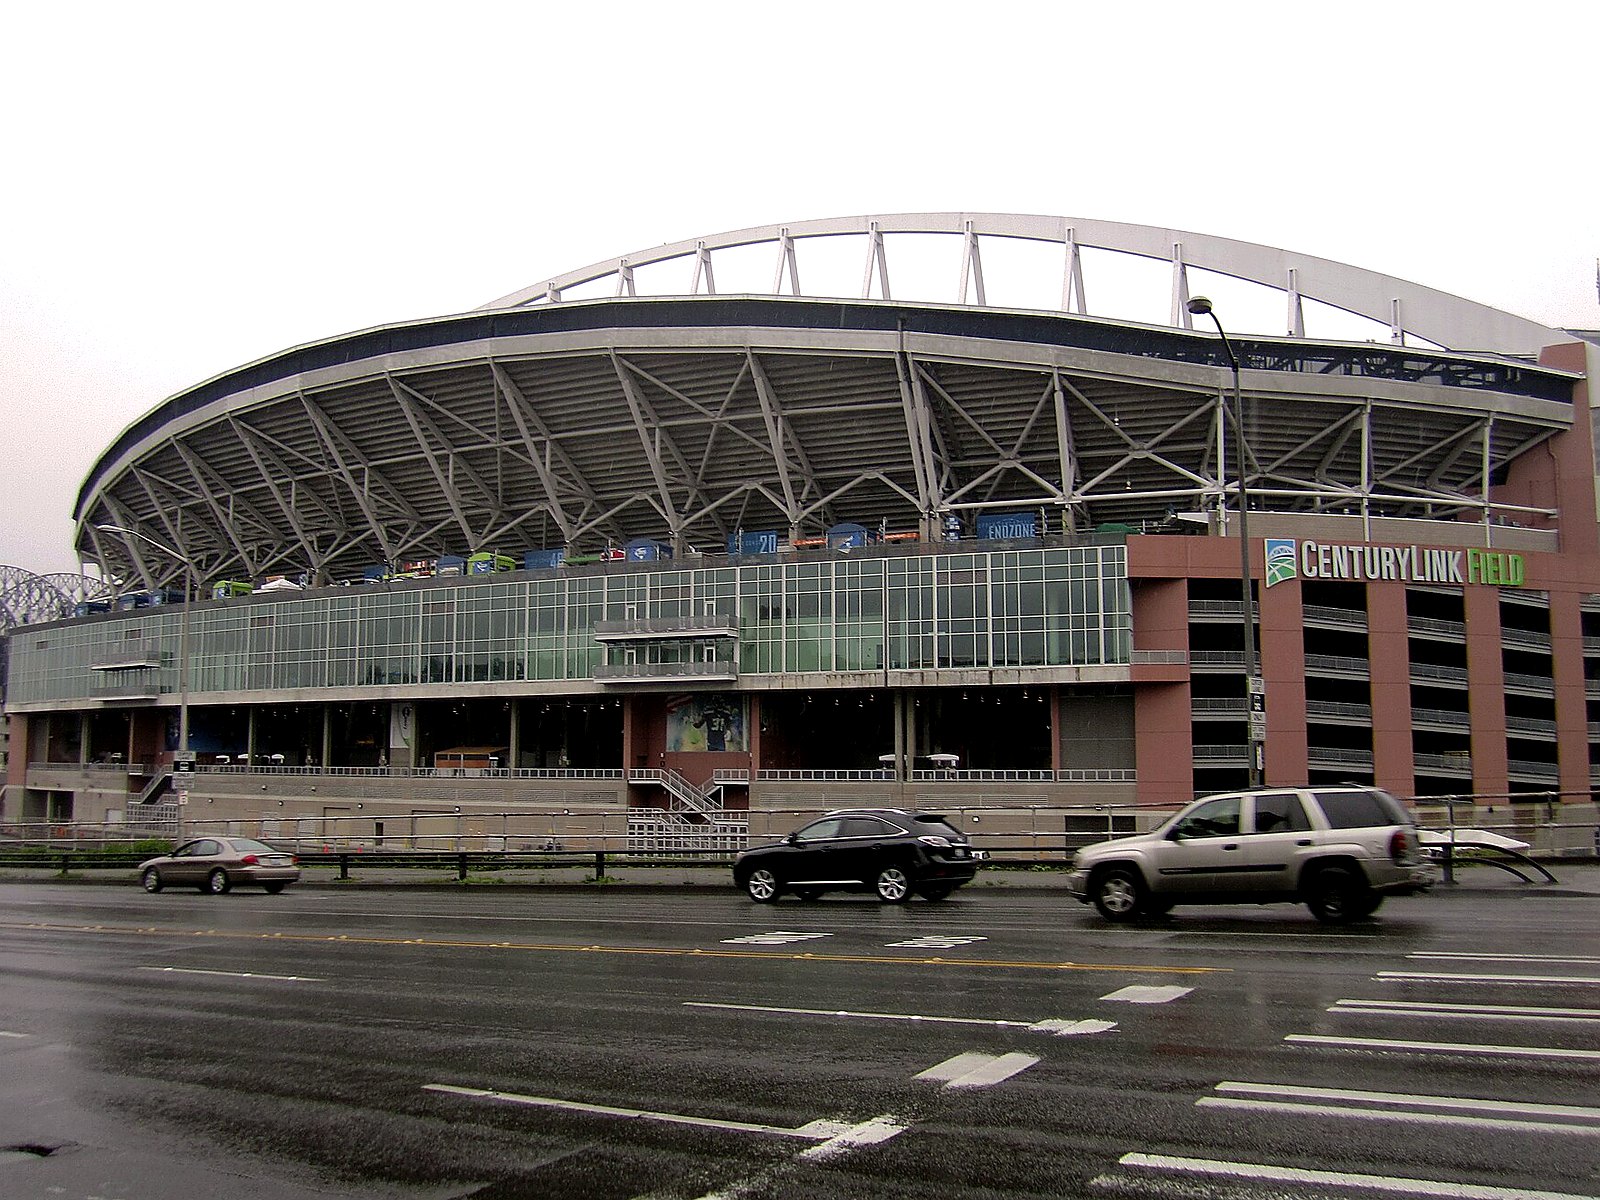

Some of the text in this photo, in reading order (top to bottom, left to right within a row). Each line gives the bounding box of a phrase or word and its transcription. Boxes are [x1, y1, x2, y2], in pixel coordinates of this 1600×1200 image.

[988, 524, 1035, 540] ENDZONE
[760, 535, 776, 553] 20
[1467, 548, 1525, 586] FIELD
